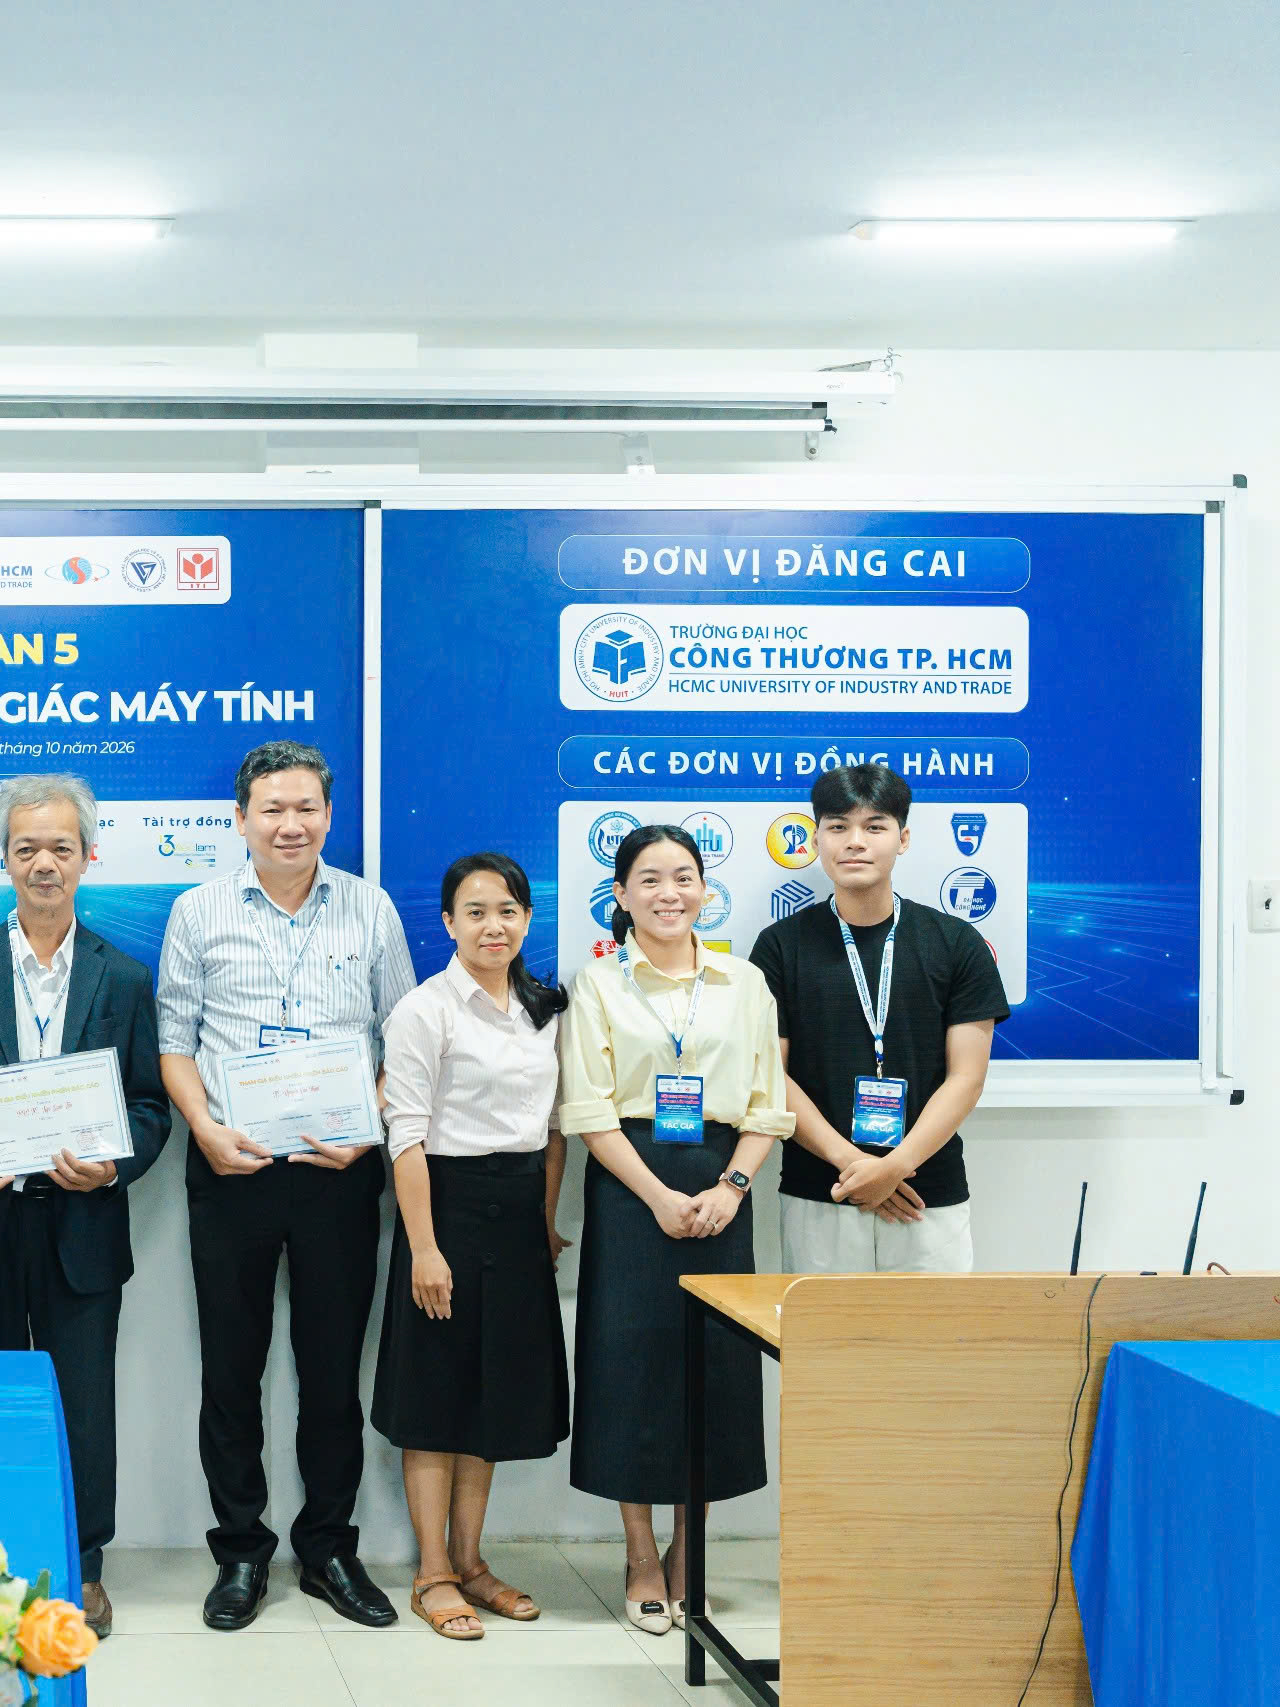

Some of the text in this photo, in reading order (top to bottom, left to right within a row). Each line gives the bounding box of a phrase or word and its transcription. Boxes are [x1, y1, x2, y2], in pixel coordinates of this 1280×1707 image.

[1, 566, 33, 577] HCM
[622, 543, 965, 584] ĐƠN VỊ ĐĂNG CAI
[588, 616, 628, 634] UNIVERSITY
[670, 624, 808, 643] TRƯỜNG ĐẠI HỌC
[53, 633, 79, 665] 5
[580, 633, 591, 649] CITY
[669, 643, 1012, 670] CÔNG THƯƠNG TP. HCM
[609, 690, 629, 698] HUIT
[669, 680, 1012, 695] HCMC UNIVERSITY OF INDUSTRY AND TRADE
[110, 682, 208, 723] MÁY
[213, 681, 314, 722] TÍNH
[46, 742, 61, 754] 10
[62, 741, 98, 754] năm
[99, 741, 136, 754] 2026
[593, 747, 656, 774] CÁC
[667, 749, 738, 775] ĐƠN
[751, 752, 783, 781] VỊ
[903, 748, 994, 776] HÀNH
[143, 817, 164, 827] Tài
[169, 817, 190, 829] trợ
